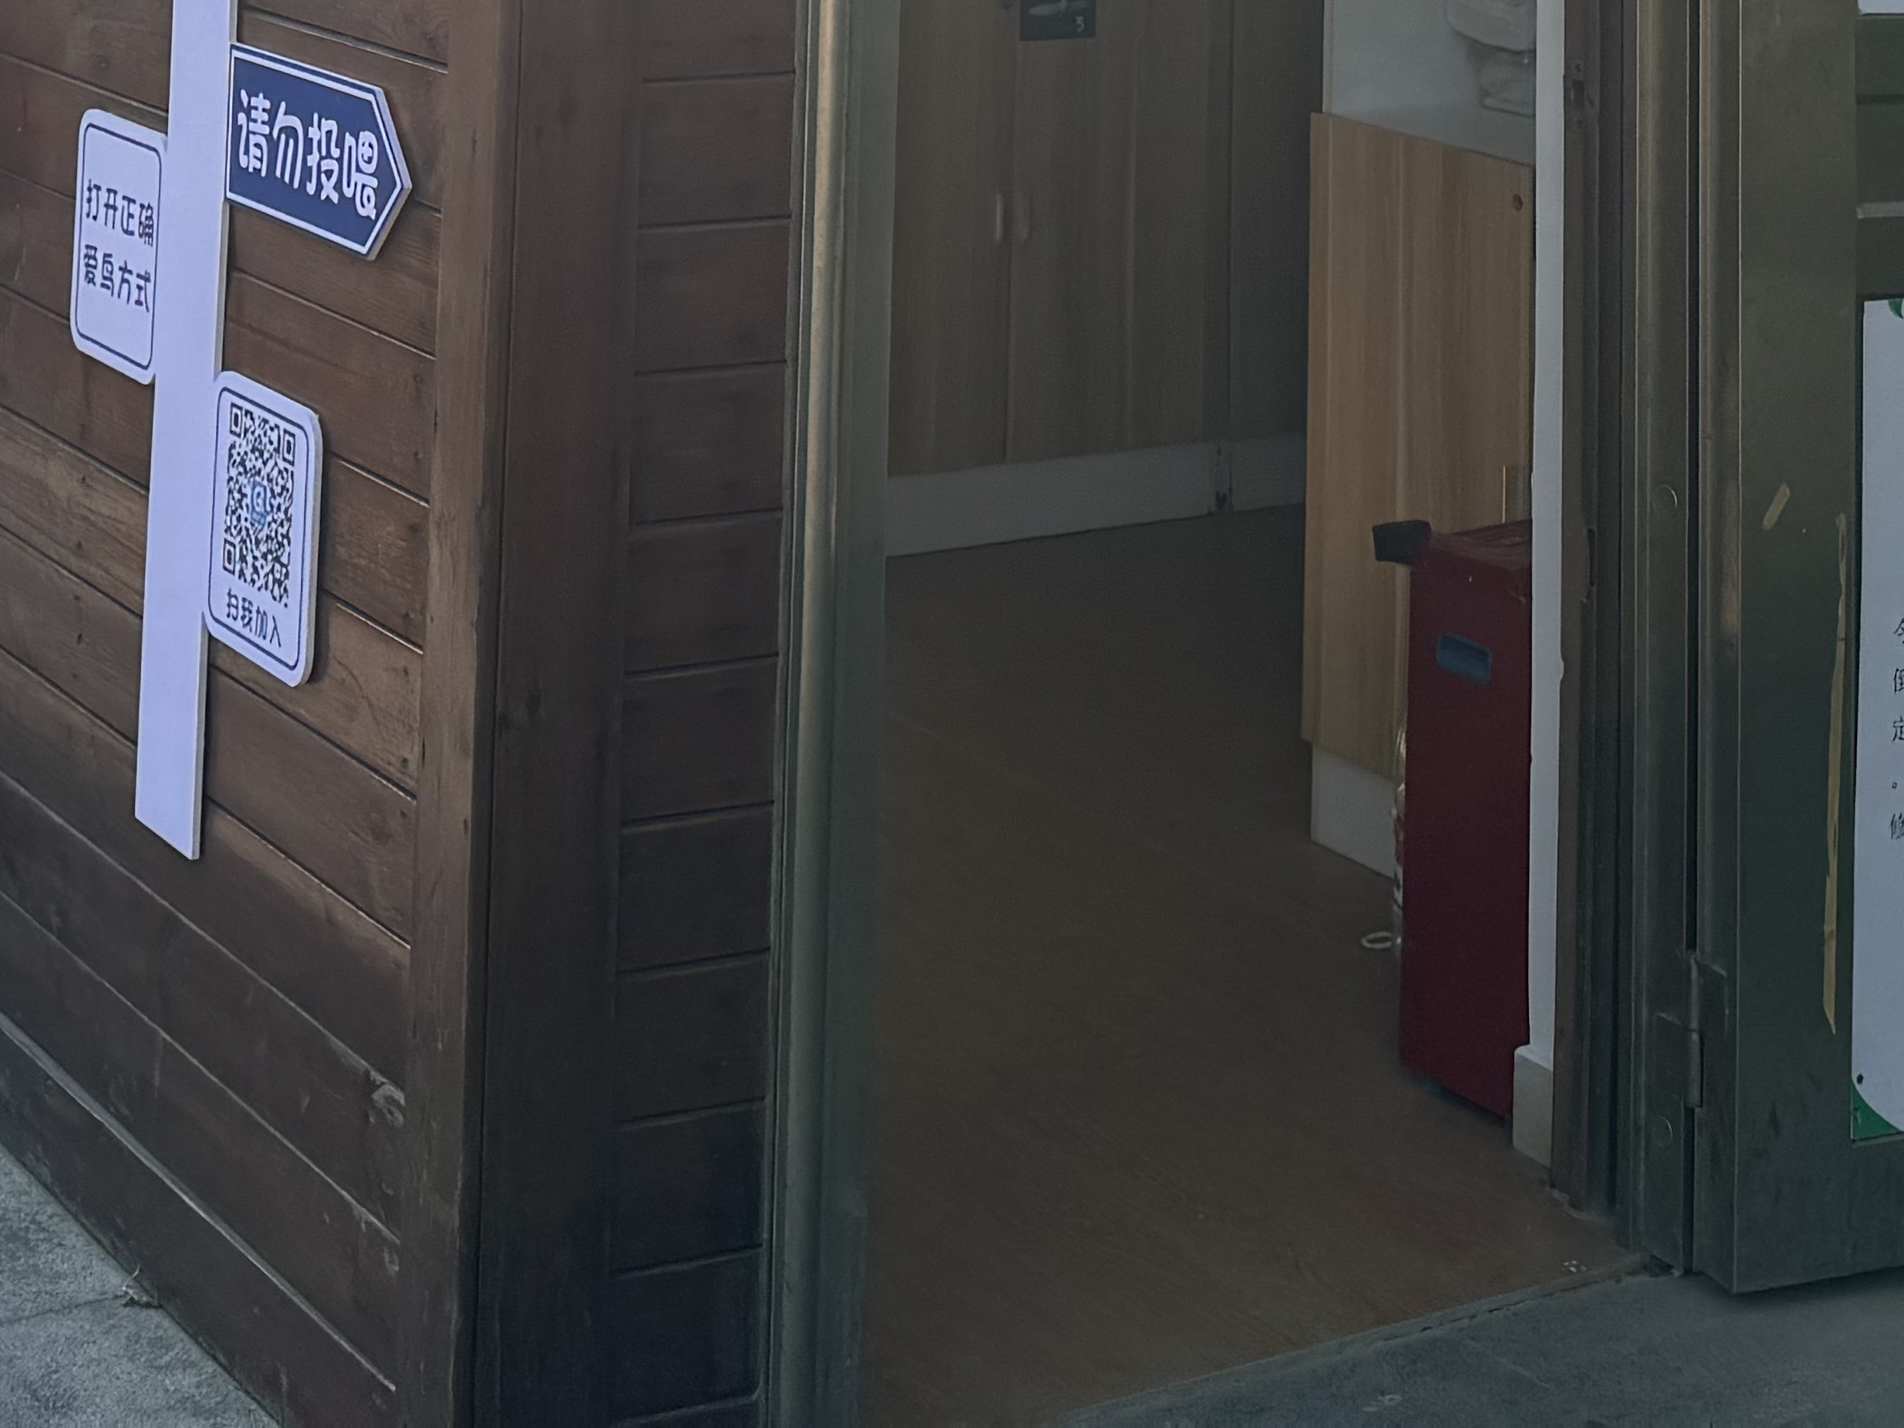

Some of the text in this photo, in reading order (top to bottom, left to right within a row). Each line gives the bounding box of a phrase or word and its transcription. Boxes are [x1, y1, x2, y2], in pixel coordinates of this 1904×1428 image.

[237, 89, 379, 221] 请勿投喂
[85, 179, 155, 246] 打开正确
[83, 244, 152, 313] 爱鸟方式
